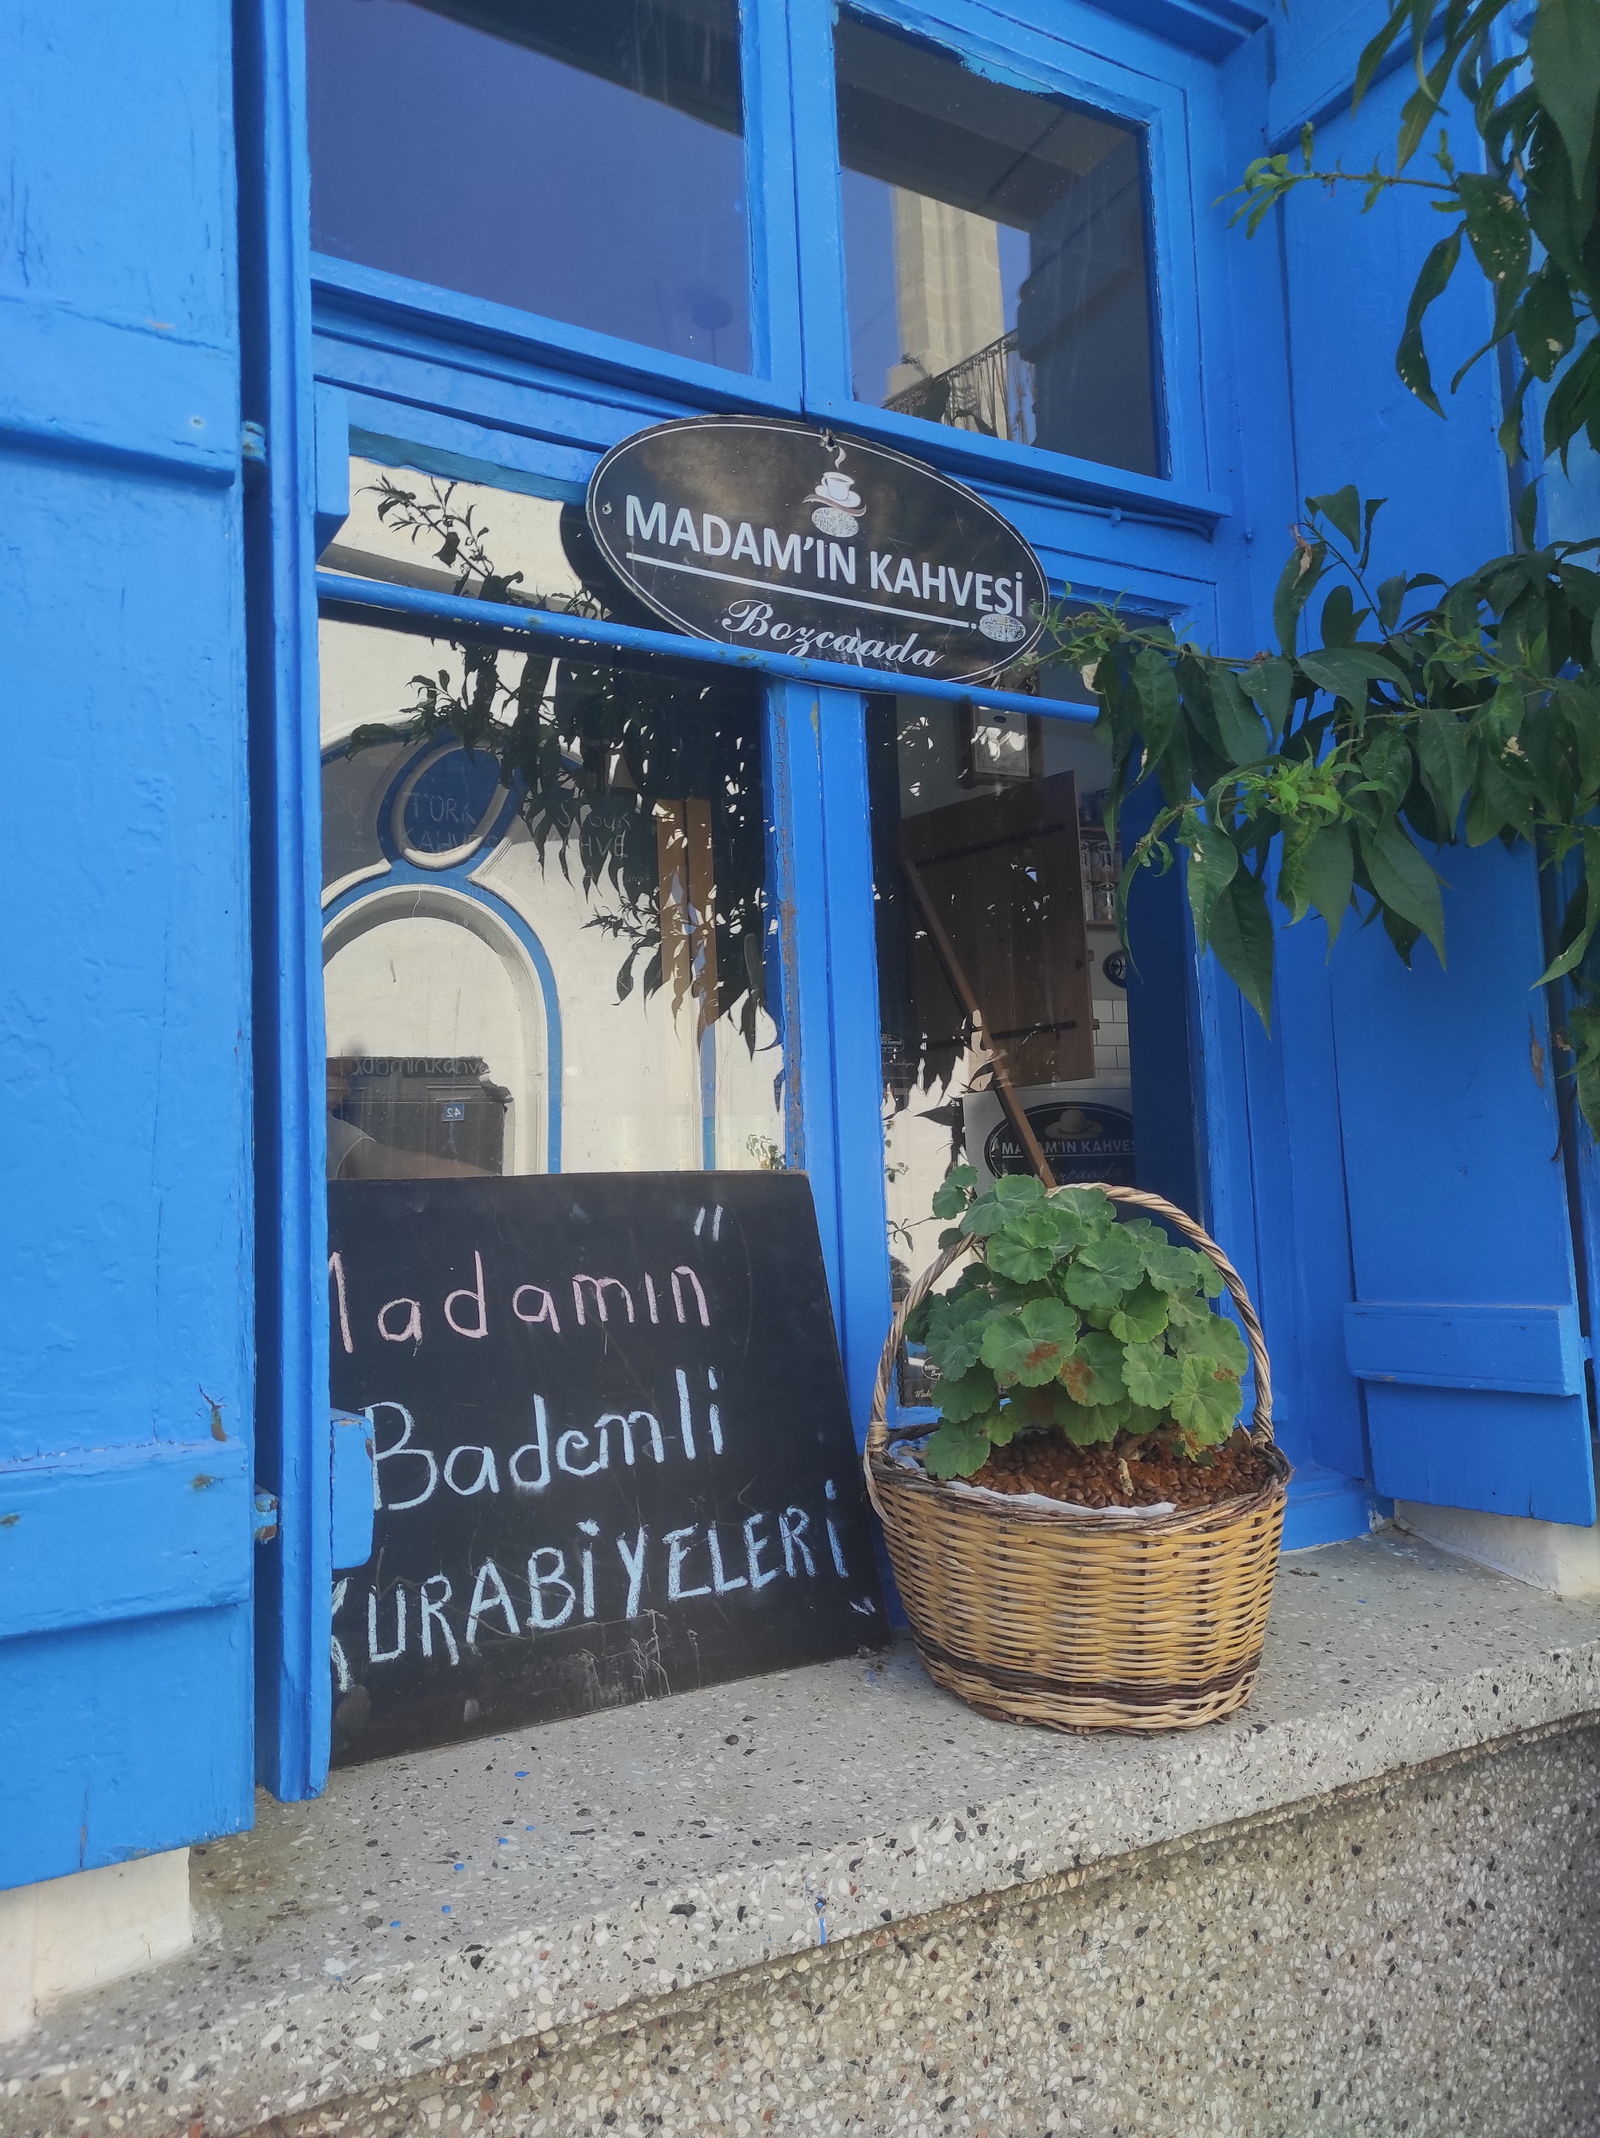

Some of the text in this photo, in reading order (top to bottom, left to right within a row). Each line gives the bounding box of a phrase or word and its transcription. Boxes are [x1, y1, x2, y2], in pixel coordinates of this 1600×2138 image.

[626, 495, 1023, 618] MADAM'IN KAHVESİ
[721, 599, 945, 668] Bozcaada
